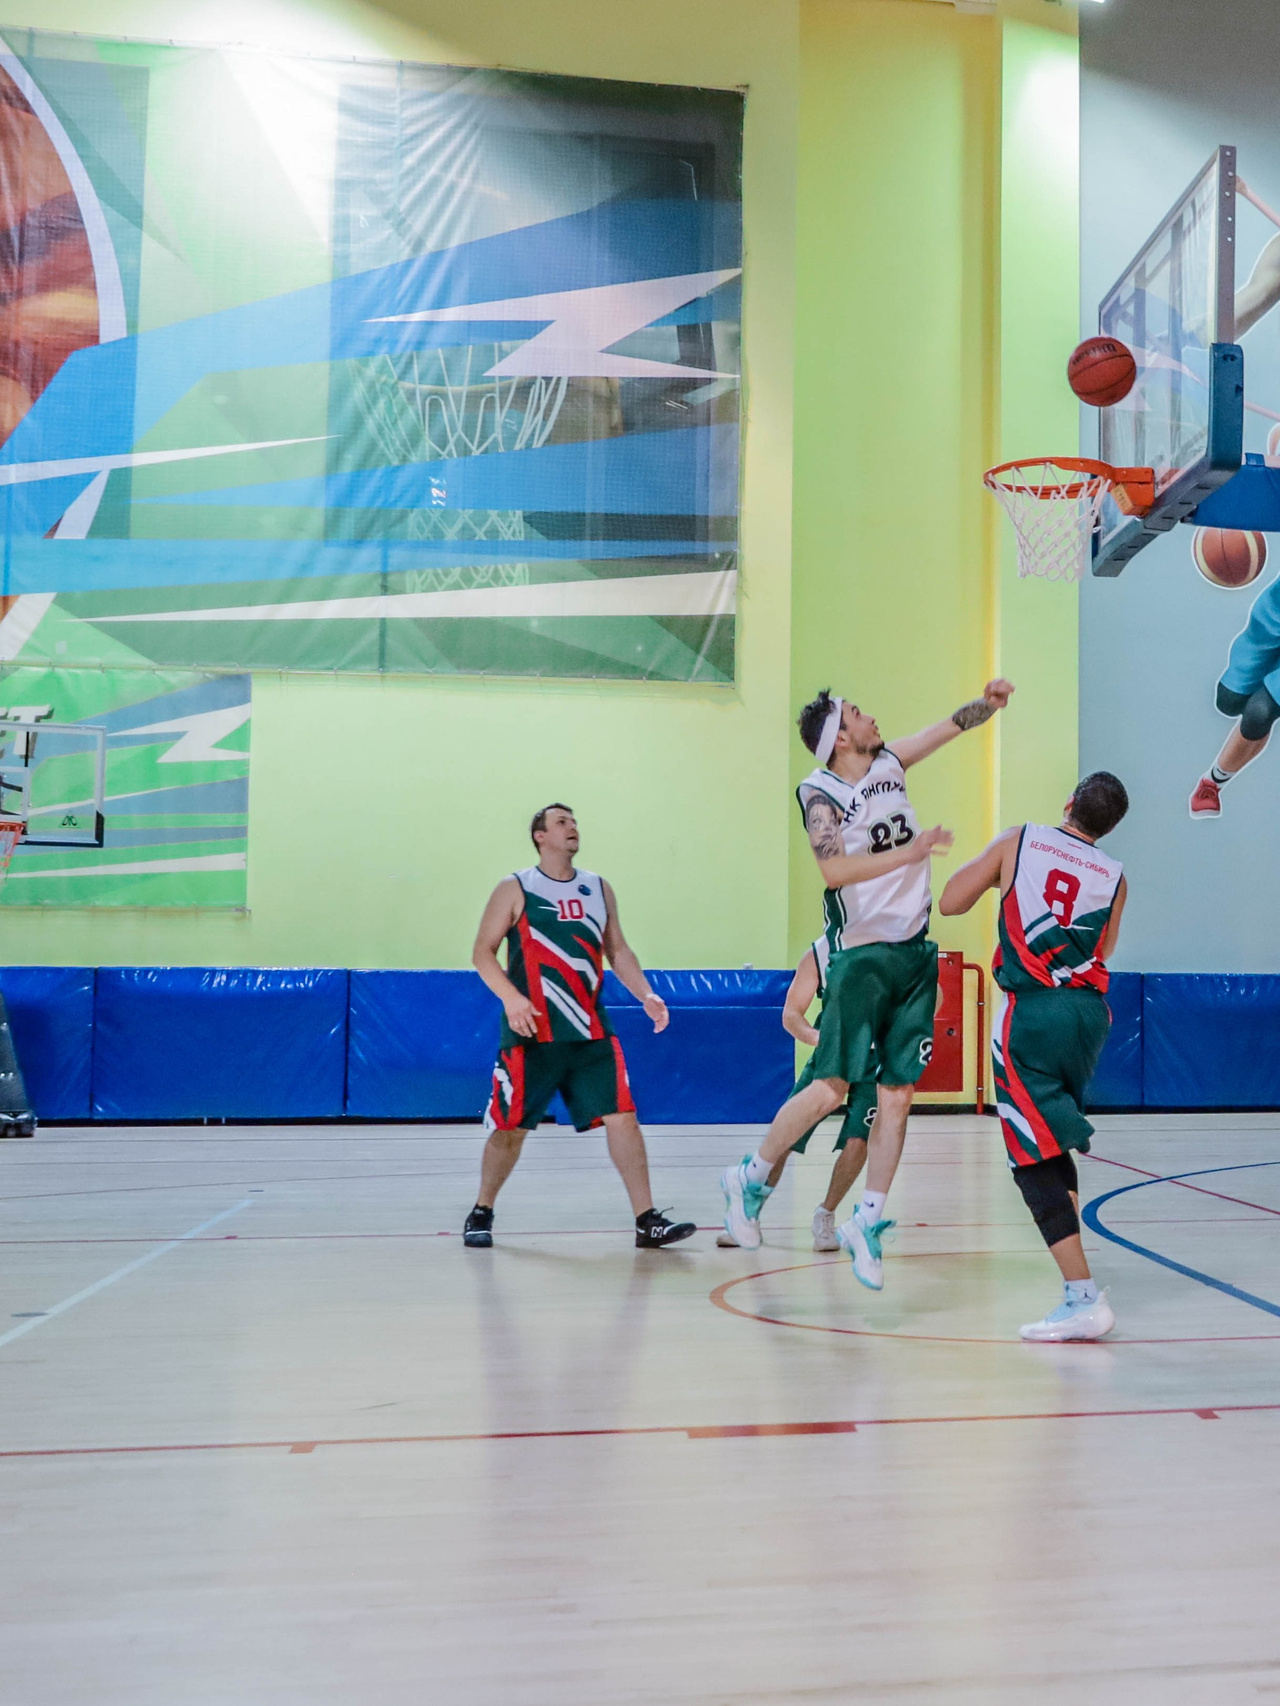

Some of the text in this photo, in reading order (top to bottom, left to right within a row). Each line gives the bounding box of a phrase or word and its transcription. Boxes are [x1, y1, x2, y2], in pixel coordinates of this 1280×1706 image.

[868, 811, 916, 855] 23
[557, 898, 585, 920] 10
[1043, 868, 1081, 928] 8
